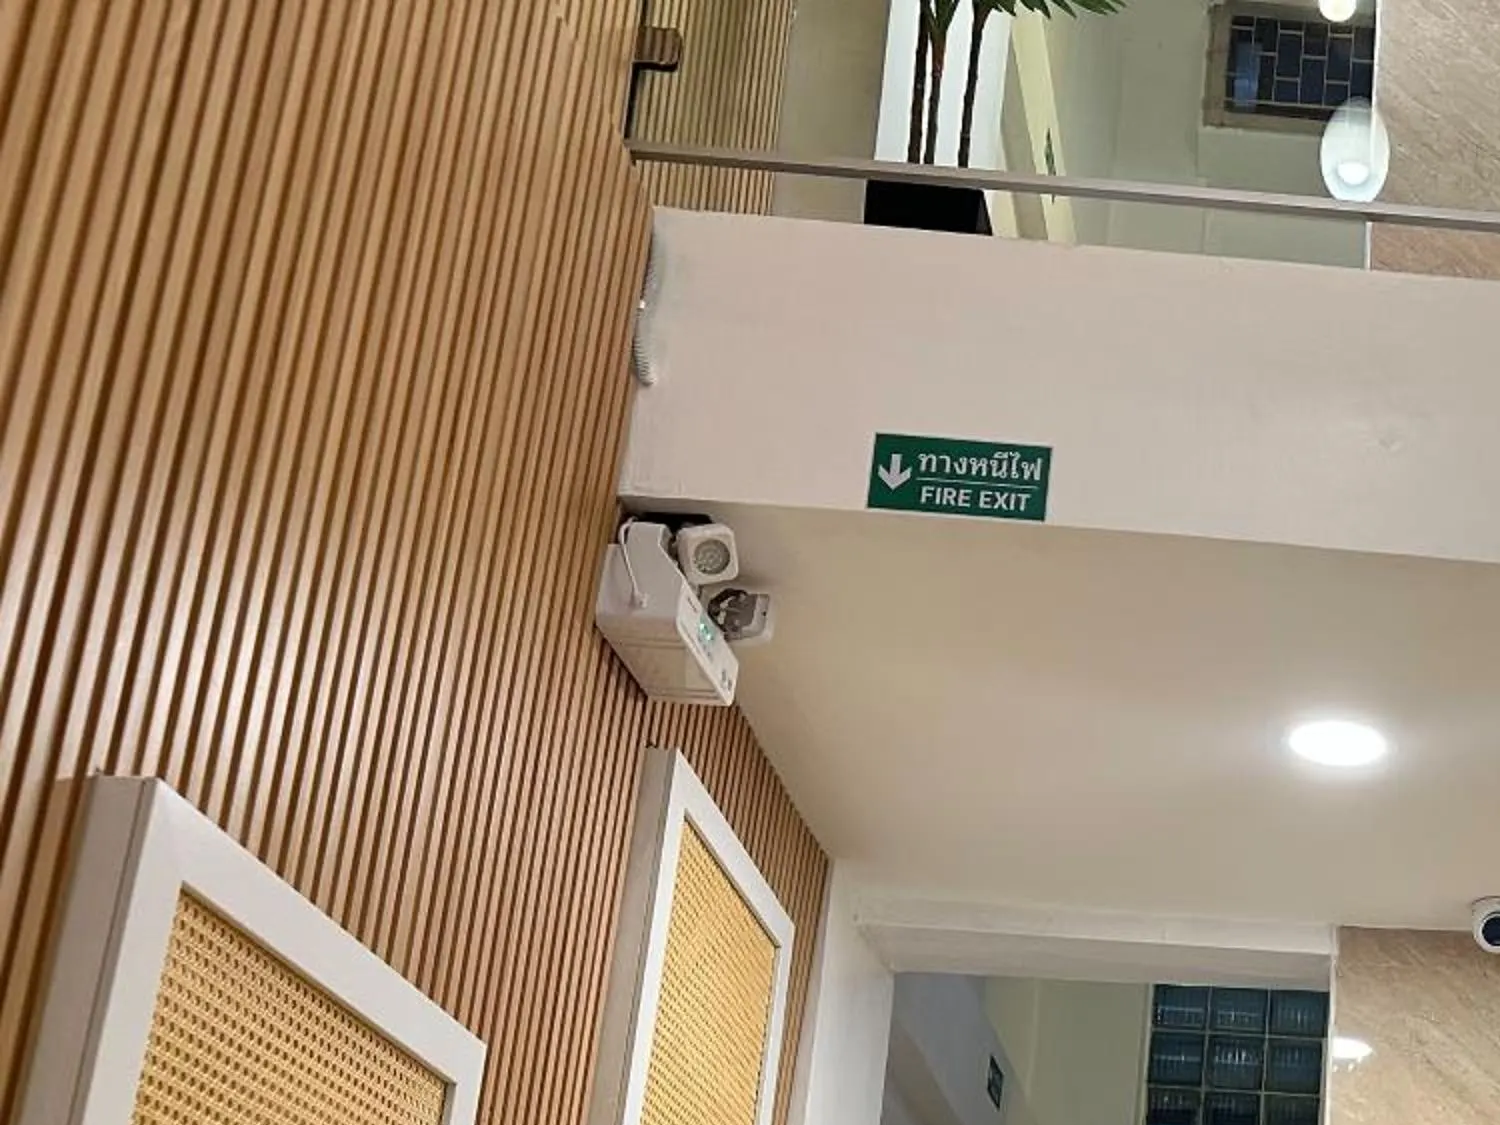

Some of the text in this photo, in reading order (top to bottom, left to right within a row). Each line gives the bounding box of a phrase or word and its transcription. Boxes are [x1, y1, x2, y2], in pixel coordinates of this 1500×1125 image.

[918, 451, 1043, 480] ทางหนีไฟ
[920, 486, 1032, 512] FIRE EXIT
